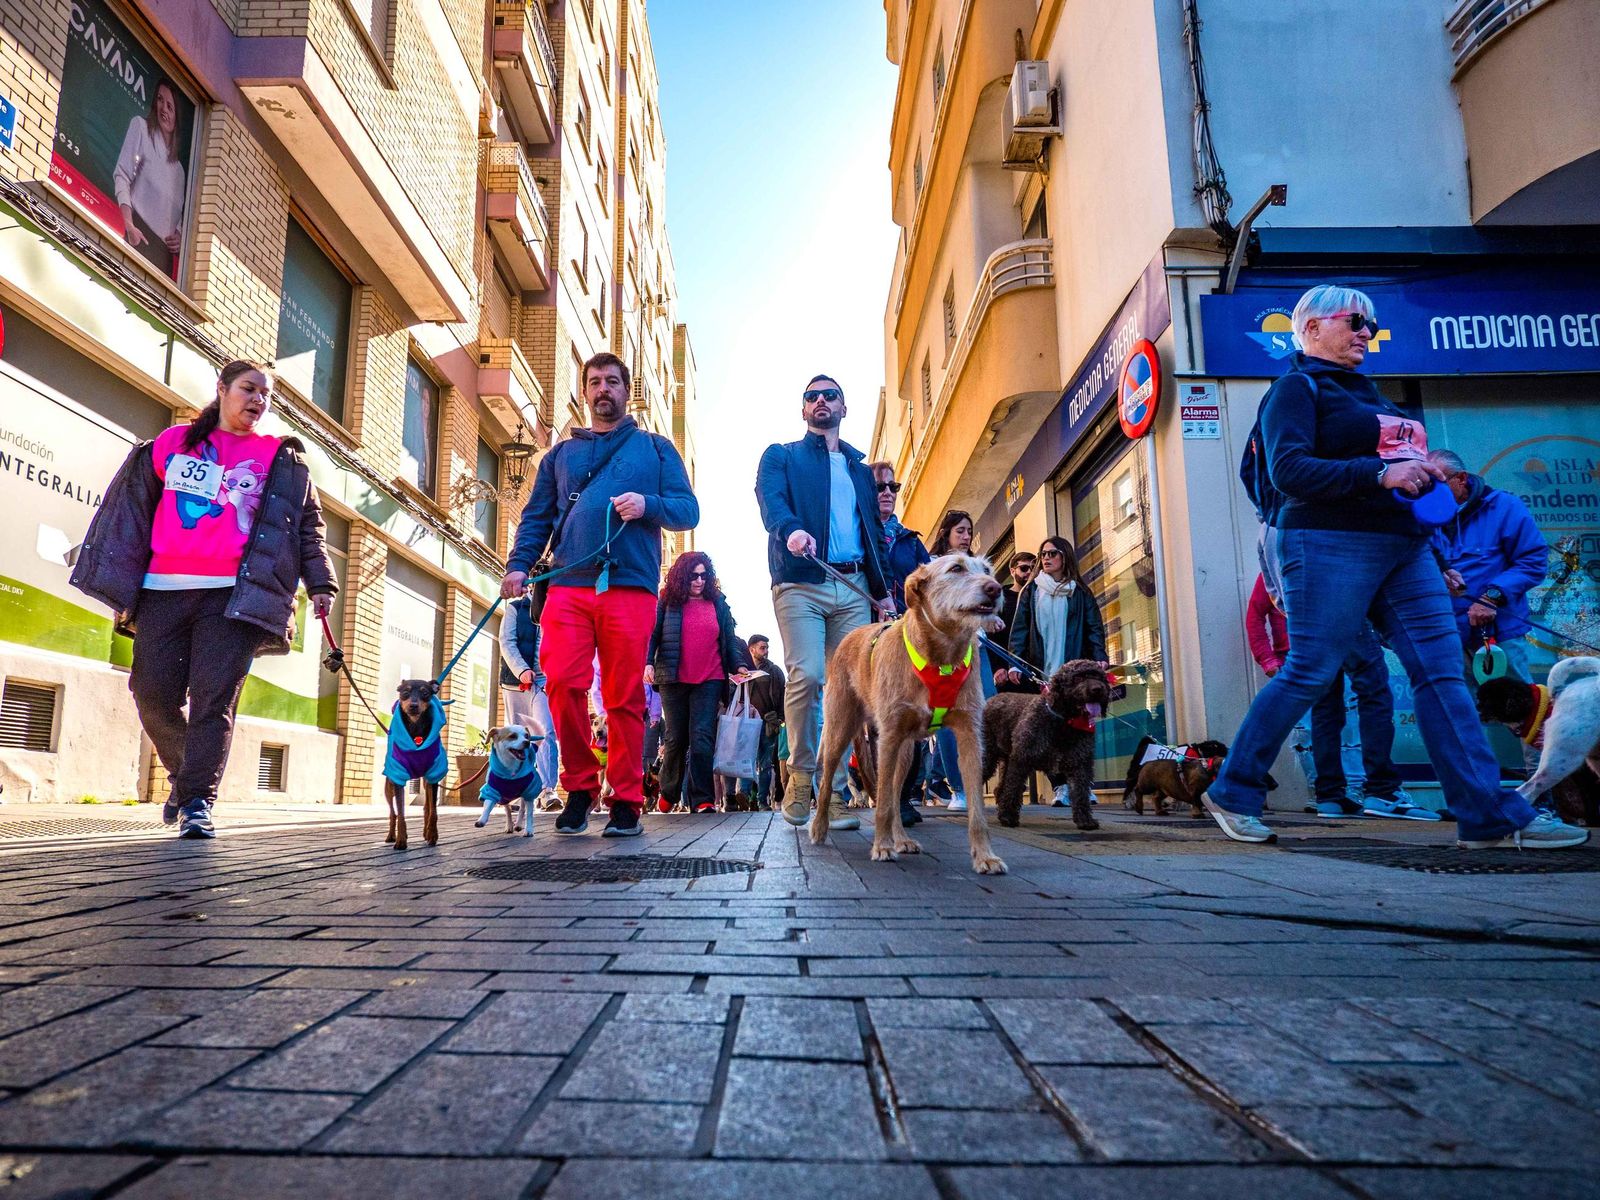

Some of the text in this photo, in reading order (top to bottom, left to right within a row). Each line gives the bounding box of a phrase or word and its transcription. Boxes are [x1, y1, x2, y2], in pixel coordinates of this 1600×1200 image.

[281, 303, 321, 349] FUNCIONA
[282, 290, 336, 349] SAN FERNANDO
[1430, 315, 1556, 349] MEDICINA
[1068, 362, 1103, 429] MEDICINA
[1103, 310, 1142, 381] GENERAL
[1182, 407, 1218, 416] Alarma
[181, 460, 210, 482] 35
[1554, 458, 1596, 471] ISLA
[0, 450, 102, 508] NTEGRALIA
[1531, 472, 1593, 485] SALUD
[1583, 513, 1598, 522] DE
[388, 626, 420, 646] INTEGRALIA
